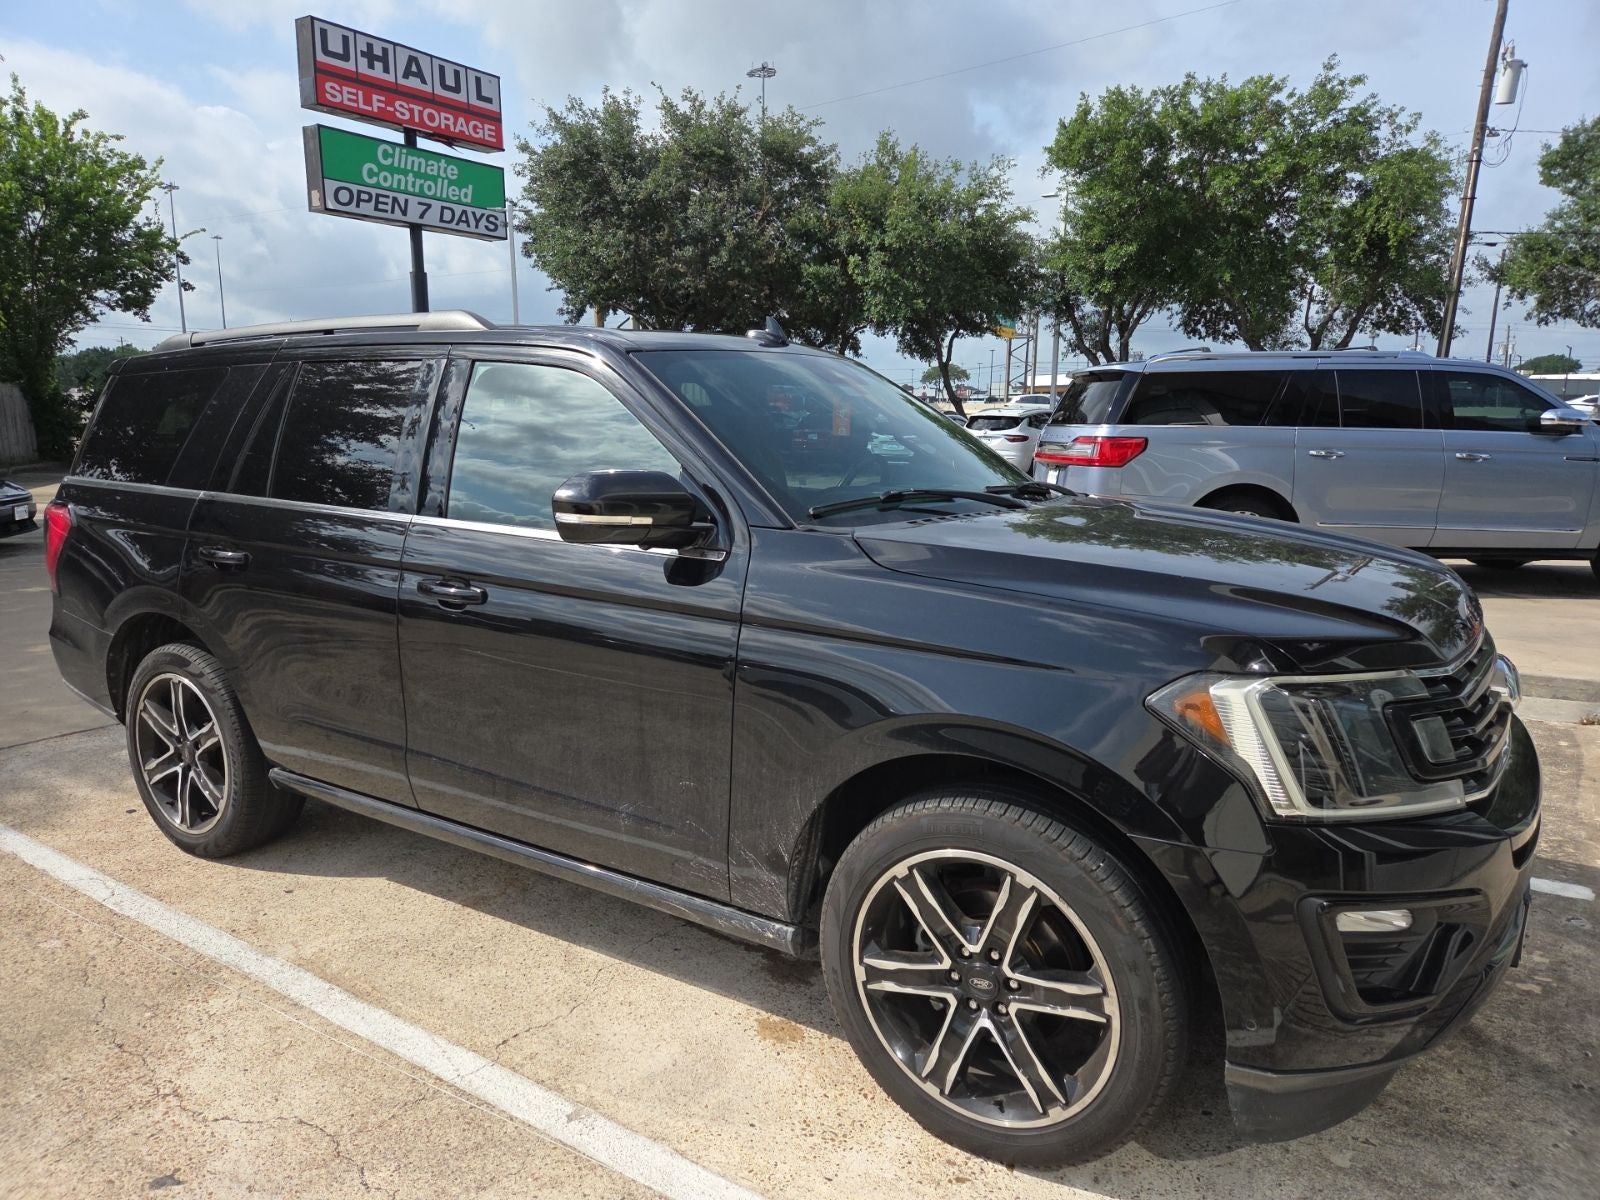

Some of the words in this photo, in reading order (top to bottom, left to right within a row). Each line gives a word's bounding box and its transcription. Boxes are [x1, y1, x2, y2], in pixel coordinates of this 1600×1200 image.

[324, 82, 497, 143] SELF-STORAGE
[362, 163, 473, 203] Controlled
[377, 144, 459, 180] Climate
[333, 186, 409, 217] OPEN
[417, 202, 432, 220] 7
[439, 205, 499, 233] DAYS
